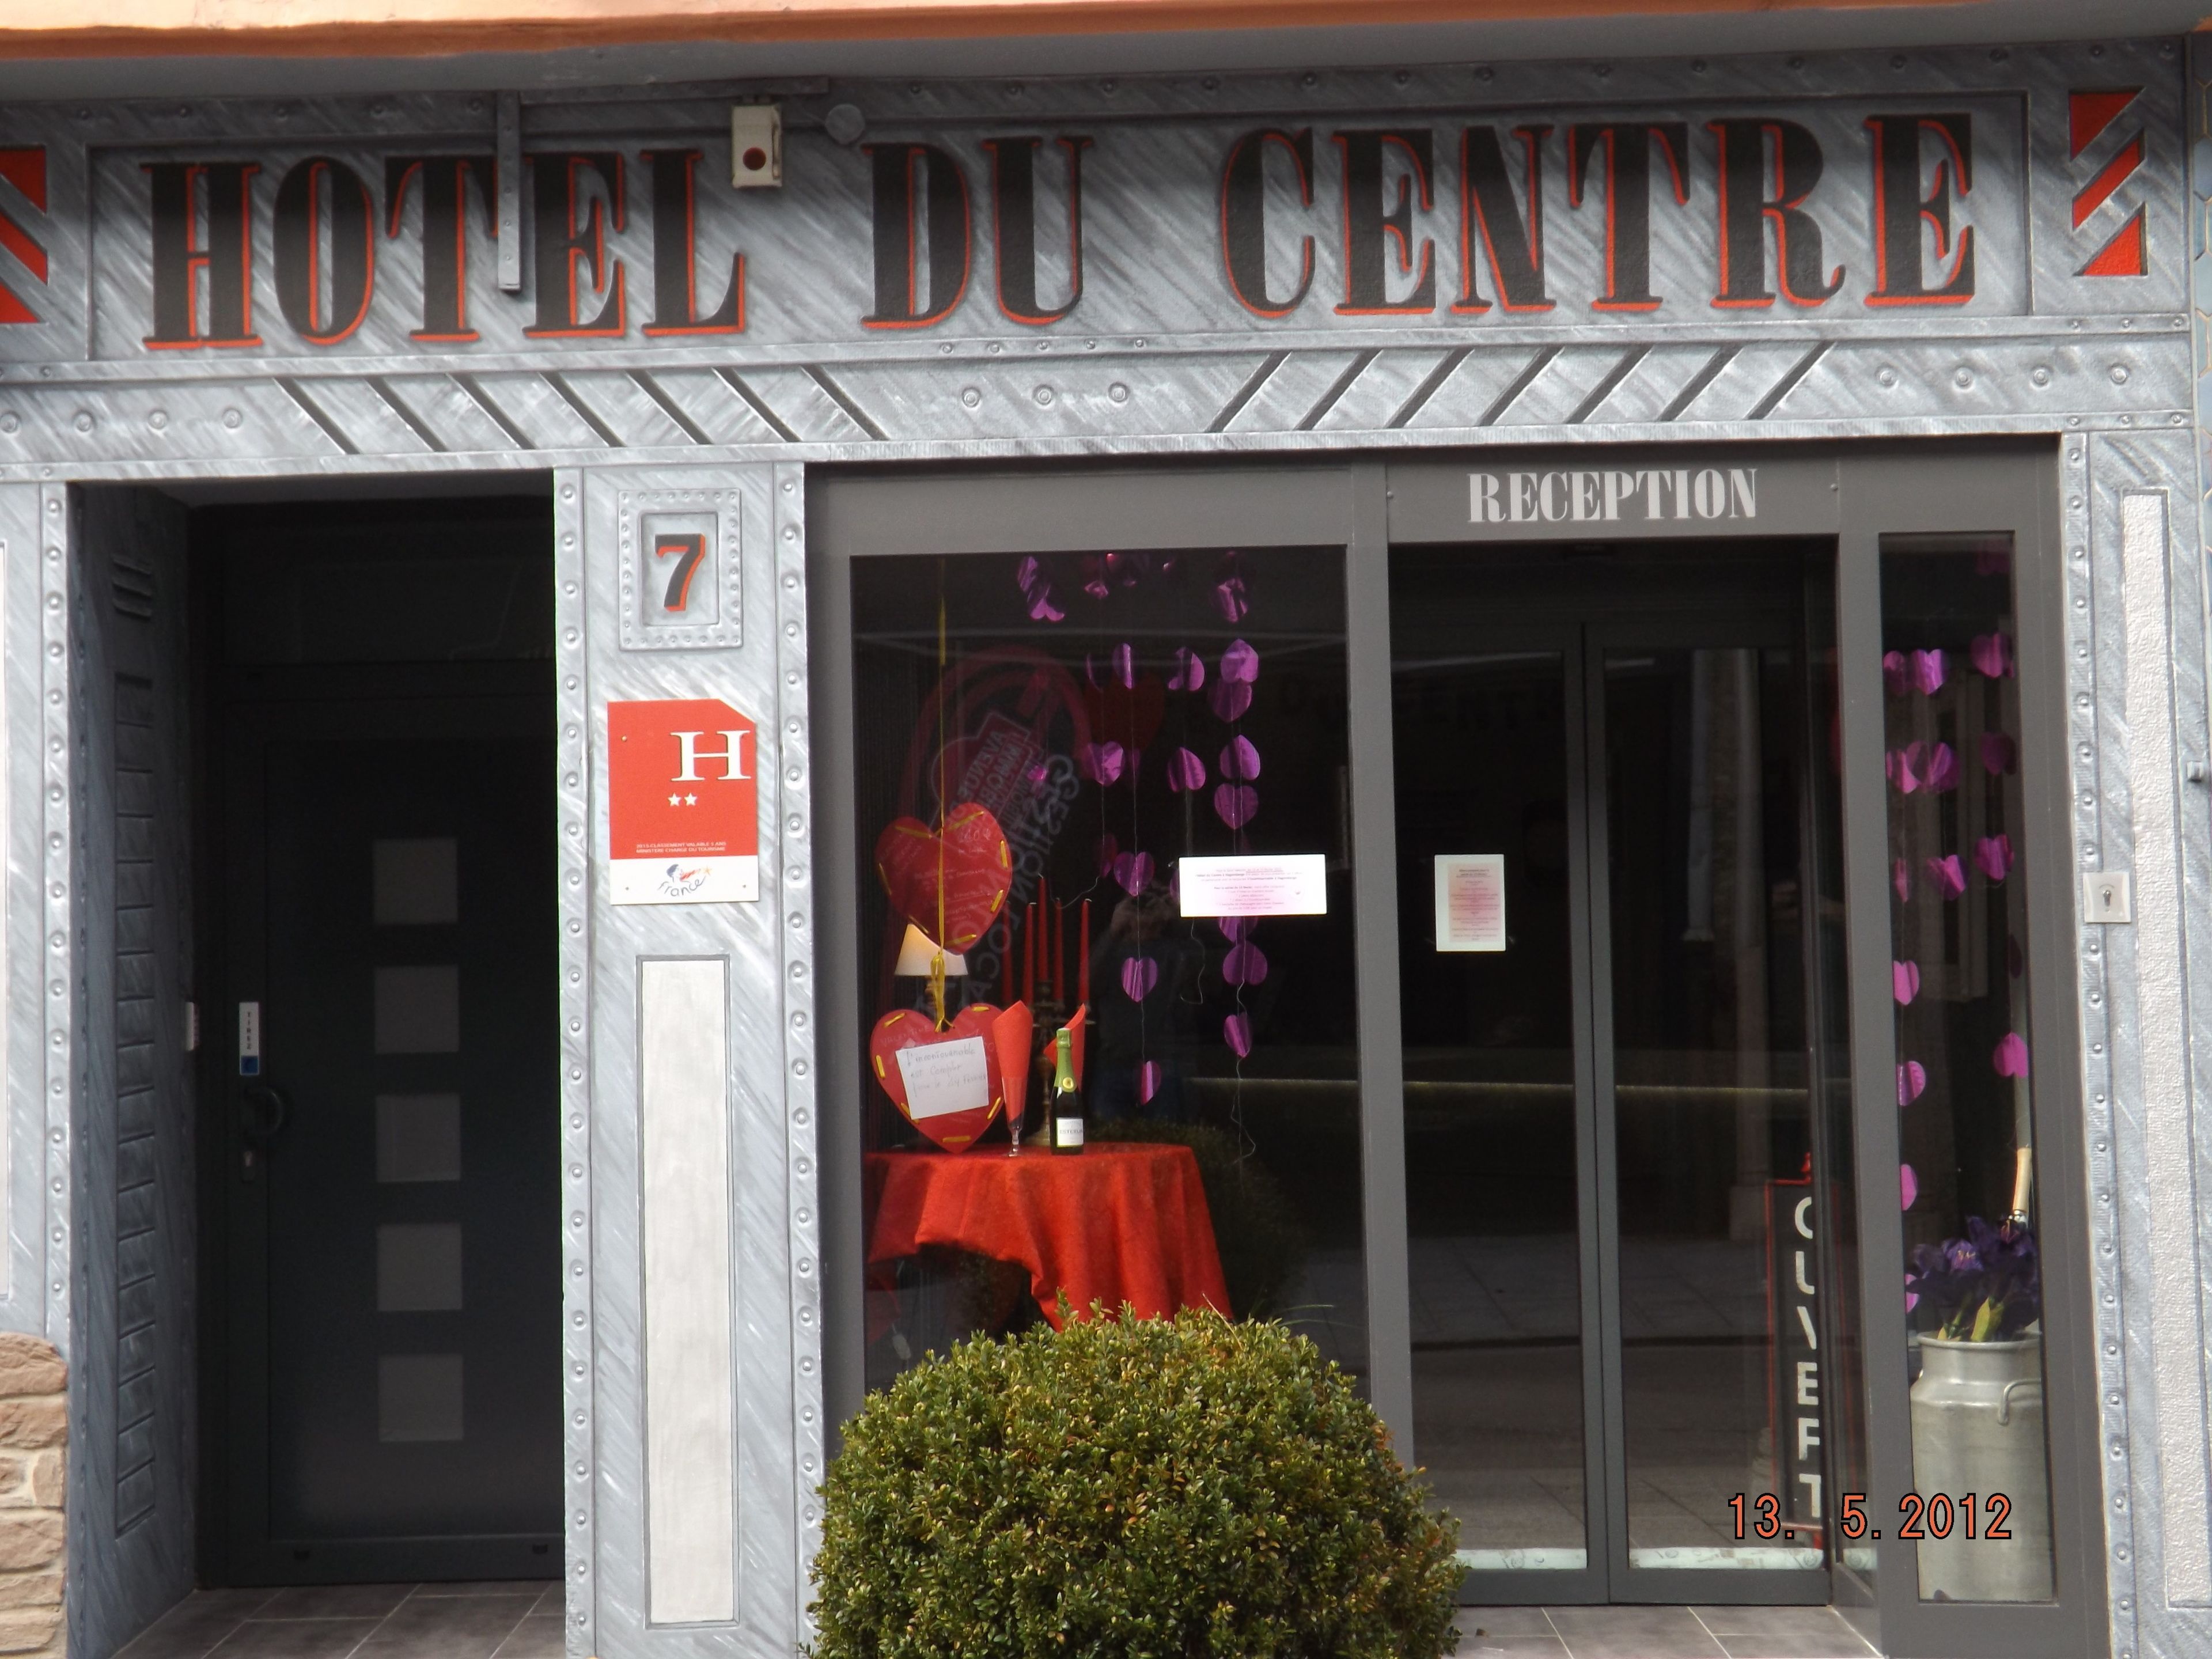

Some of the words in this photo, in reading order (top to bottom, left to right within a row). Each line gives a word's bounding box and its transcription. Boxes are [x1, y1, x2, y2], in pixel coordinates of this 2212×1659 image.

[142, 148, 745, 351] HOTEL
[861, 135, 1094, 329] DU
[1220, 113, 1976, 319] CENTRE
[1467, 468, 1758, 524] RECEPTION
[654, 533, 706, 612] 7
[670, 729, 752, 782] H
